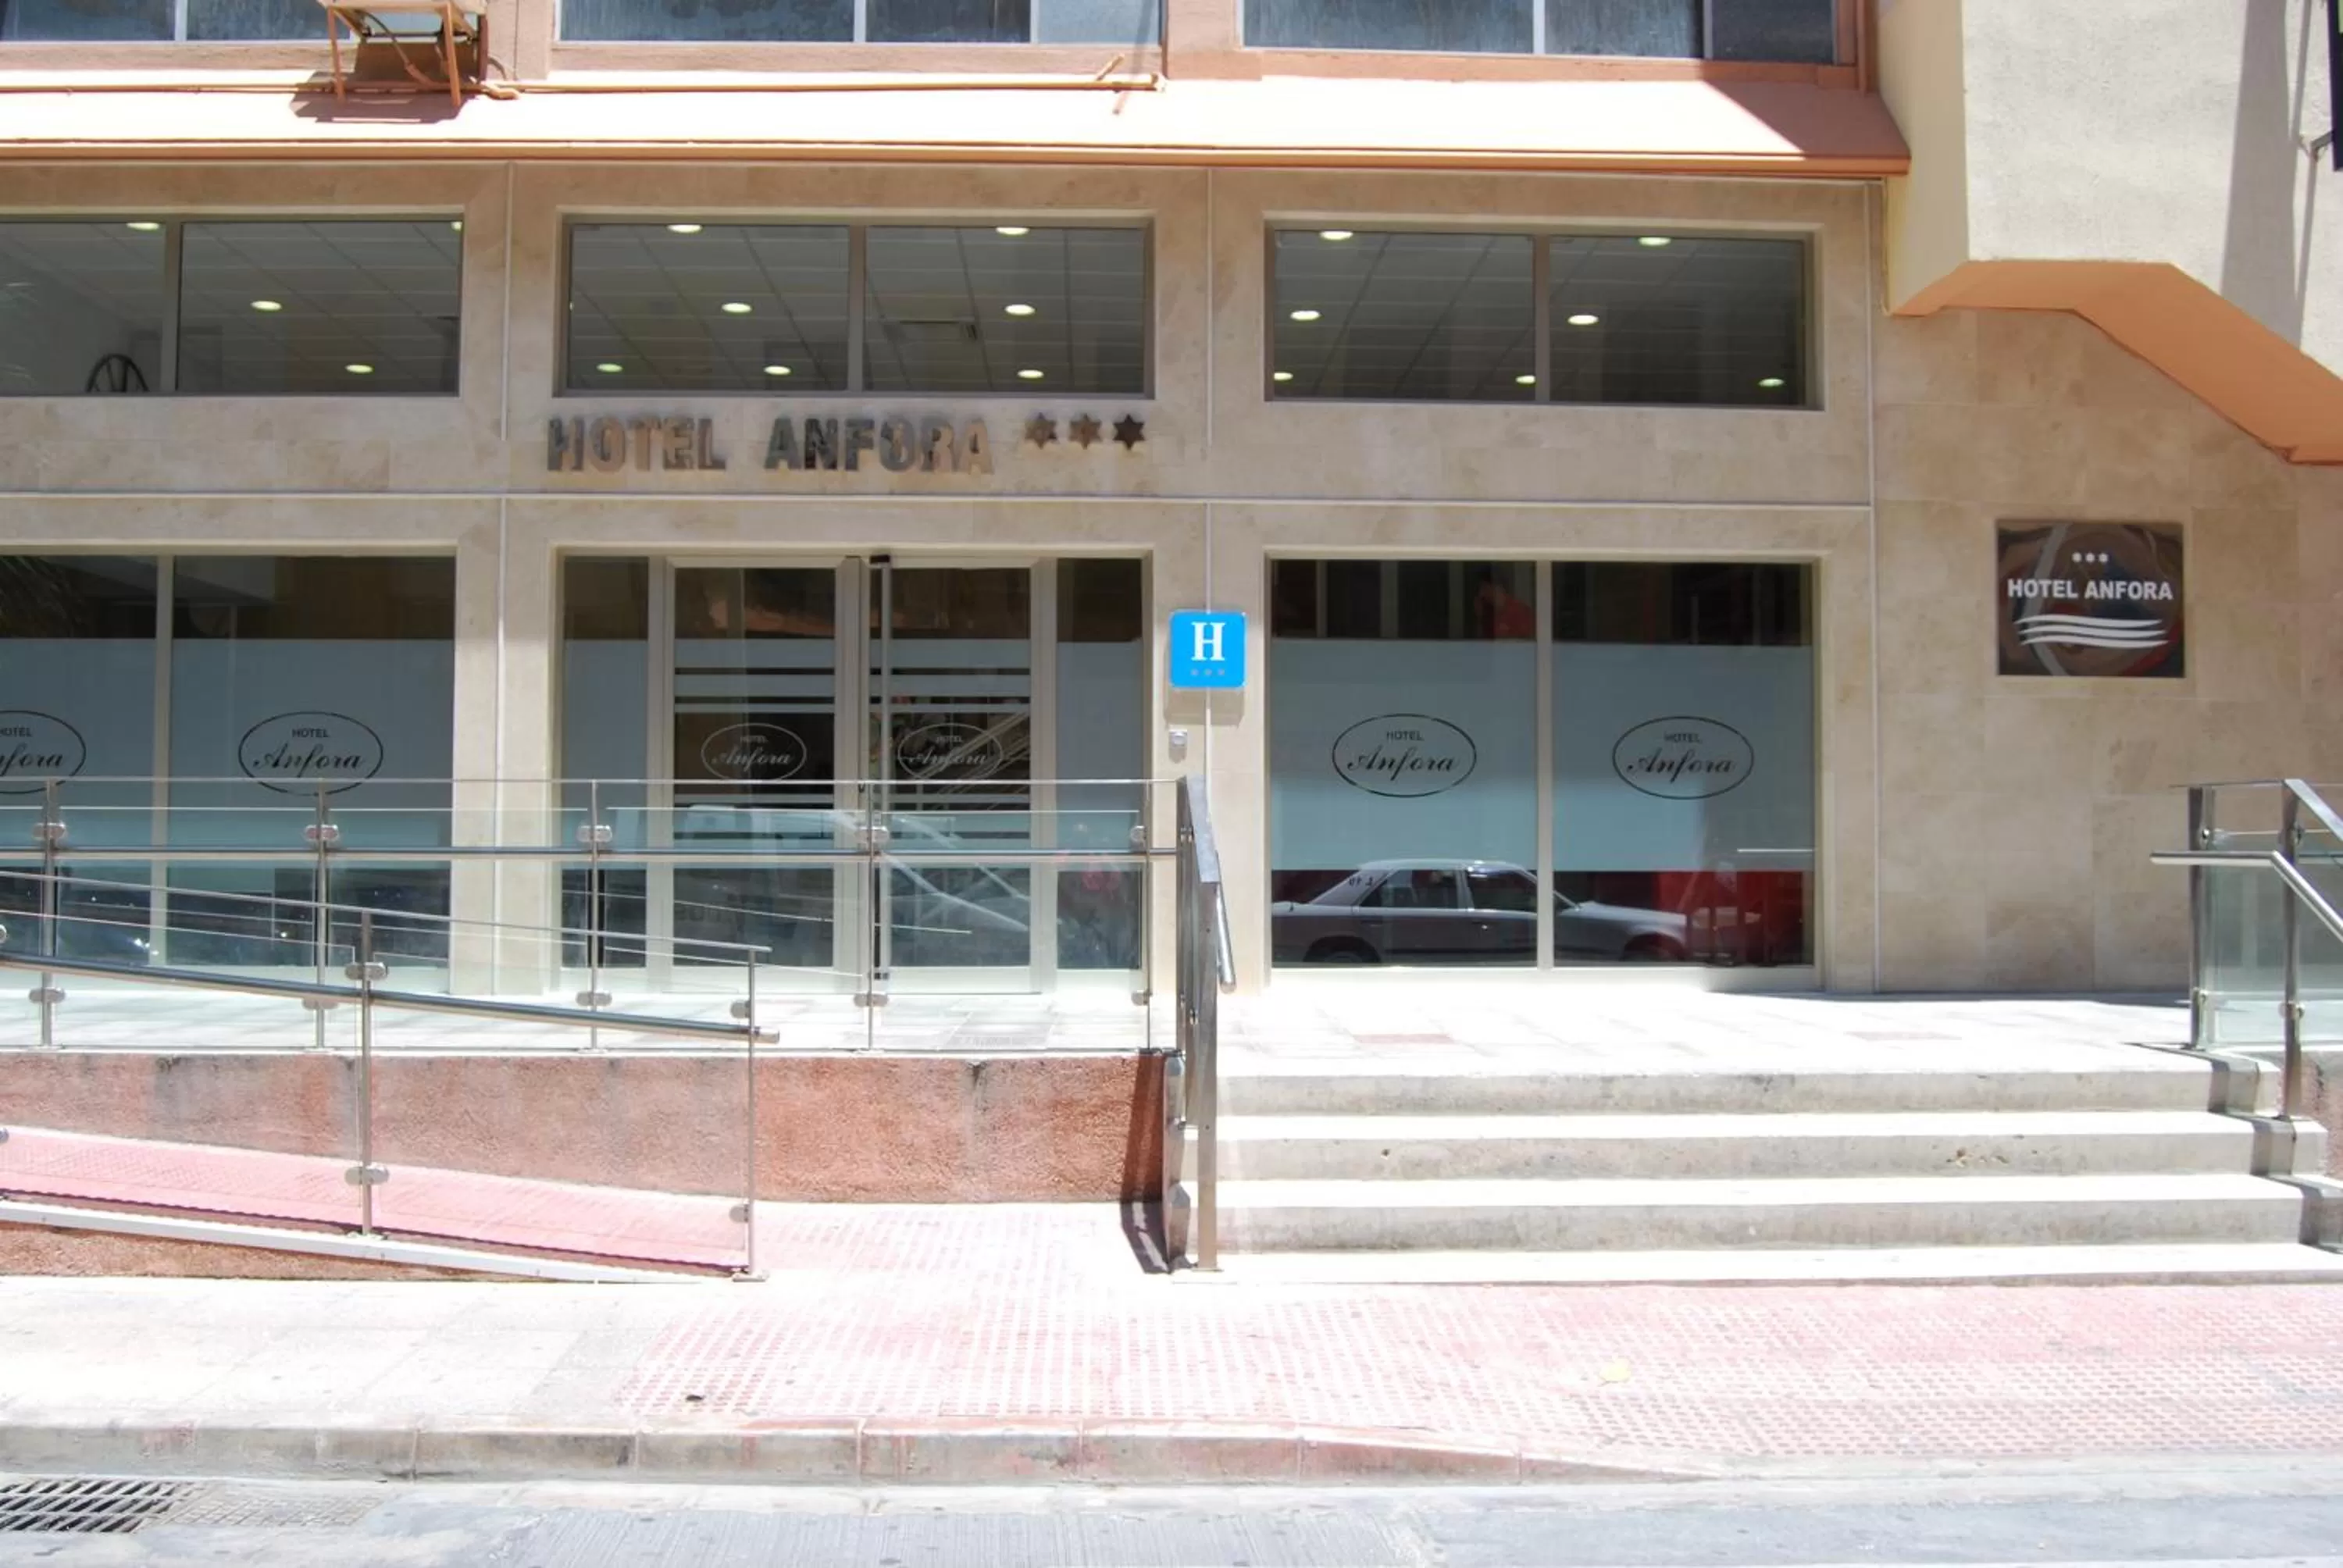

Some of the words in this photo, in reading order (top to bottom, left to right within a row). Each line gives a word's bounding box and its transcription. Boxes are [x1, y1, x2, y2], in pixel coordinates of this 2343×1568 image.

[547, 415, 726, 472] HOTEL
[764, 415, 994, 473] ANFORA
[2006, 579, 2078, 599] HOTEL
[2084, 580, 2174, 600] ANFORA
[1191, 622, 1226, 661] H
[291, 728, 330, 738] HOTEL
[1386, 730, 1425, 741] HOTEL
[1664, 732, 1703, 743] HOTEL
[252, 743, 362, 778] Anfora
[711, 744, 792, 772] Anfora
[1346, 744, 1457, 782] Anfora
[1626, 747, 1735, 784] Anfora
